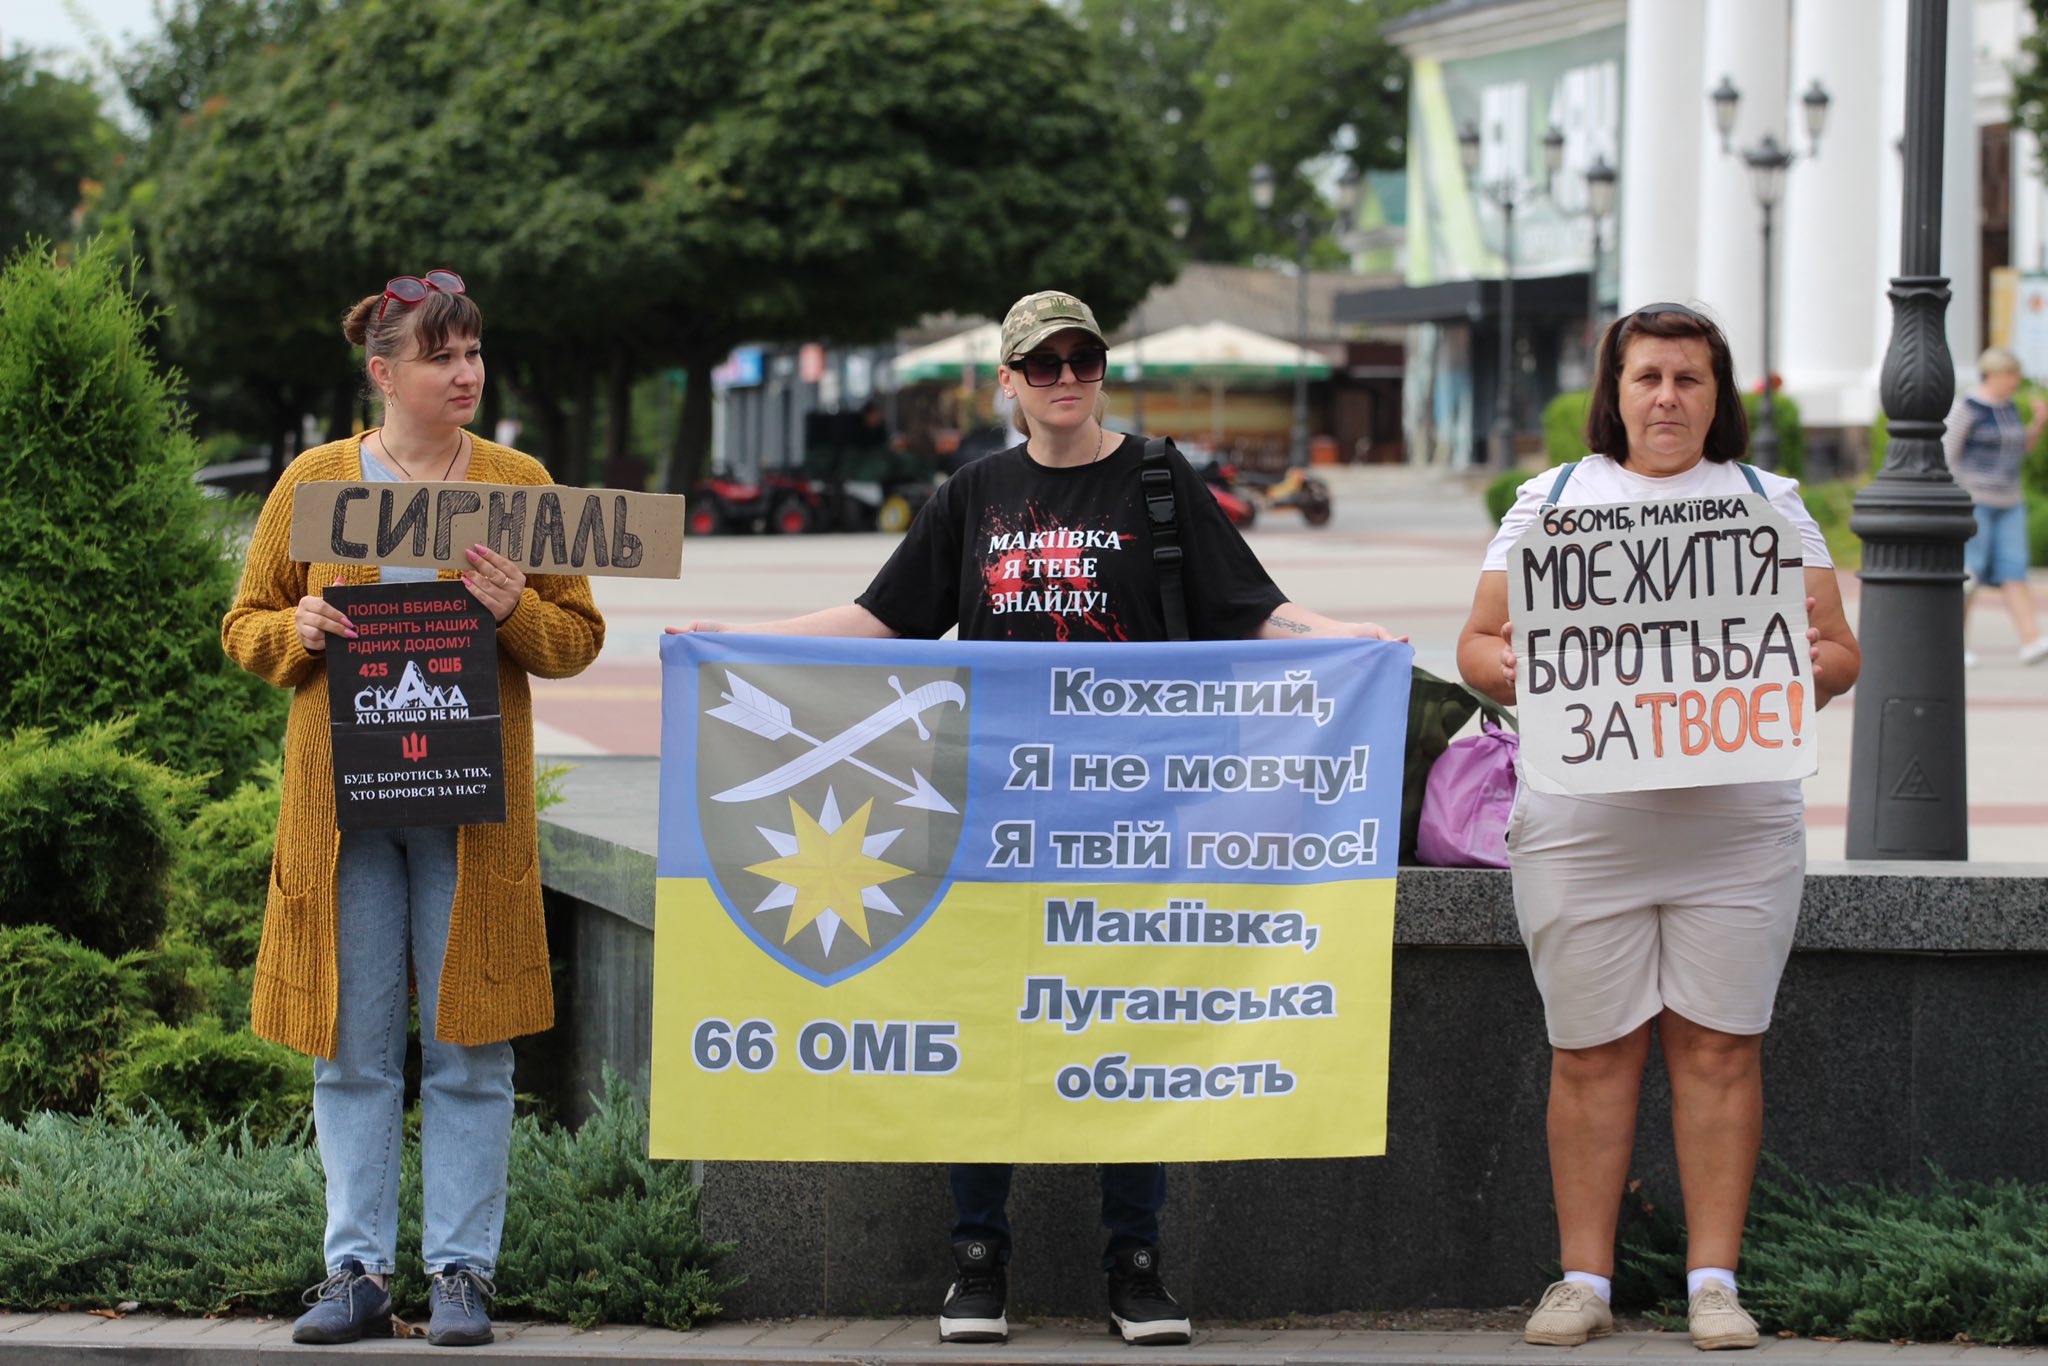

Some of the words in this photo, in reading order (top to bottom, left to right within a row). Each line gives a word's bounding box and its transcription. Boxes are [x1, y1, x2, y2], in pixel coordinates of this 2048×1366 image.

[330, 487, 643, 568] СИГНАЛЬ
[988, 527, 1122, 554] МАКІЇВКА
[1002, 559, 1021, 580] Я
[1029, 557, 1098, 578] ТЕБЕ
[347, 603, 400, 617] ПОЛОН
[403, 599, 467, 614] ВБИВАЄ!
[992, 584, 1108, 617] ЗНАЙДУ!
[348, 639, 400, 655] РІДНИХ
[404, 636, 471, 652] ДОДОМУ!
[352, 621, 421, 635] ОВЕРНІТЬ
[425, 618, 479, 633] НАШИХ
[358, 663, 389, 677] 425
[428, 657, 463, 674] ОШБ
[1528, 612, 1800, 695] БОРОТЬБА
[354, 660, 468, 711] СКАЛА
[1050, 667, 1334, 726] Коханий,
[355, 711, 385, 725] ХТО,
[387, 709, 427, 724] ЯКЩО
[430, 708, 447, 721] НЕ
[450, 707, 470, 720] МИ
[344, 773, 375, 786] БУДЕ
[377, 769, 443, 783] БОРОТИСЬ
[445, 768, 460, 780] ЗА
[462, 766, 492, 779] ТИХ,
[350, 790, 376, 801] ХТО
[378, 786, 436, 800] БОРОВСЯ
[438, 785, 453, 797] ЗА
[456, 783, 487, 796] НАС?
[1003, 744, 1054, 792] Я
[1070, 749, 1150, 792] не
[1164, 745, 1369, 804] мовчу!
[985, 822, 1036, 868] Я
[1048, 824, 1170, 868] твій
[1188, 818, 1380, 868] голос!
[1044, 898, 1319, 952] Макіївка,
[1018, 977, 1337, 1032] Луганська
[692, 1020, 777, 1072] 66
[797, 1022, 960, 1075] ОМБ
[1055, 1055, 1296, 1101] область
